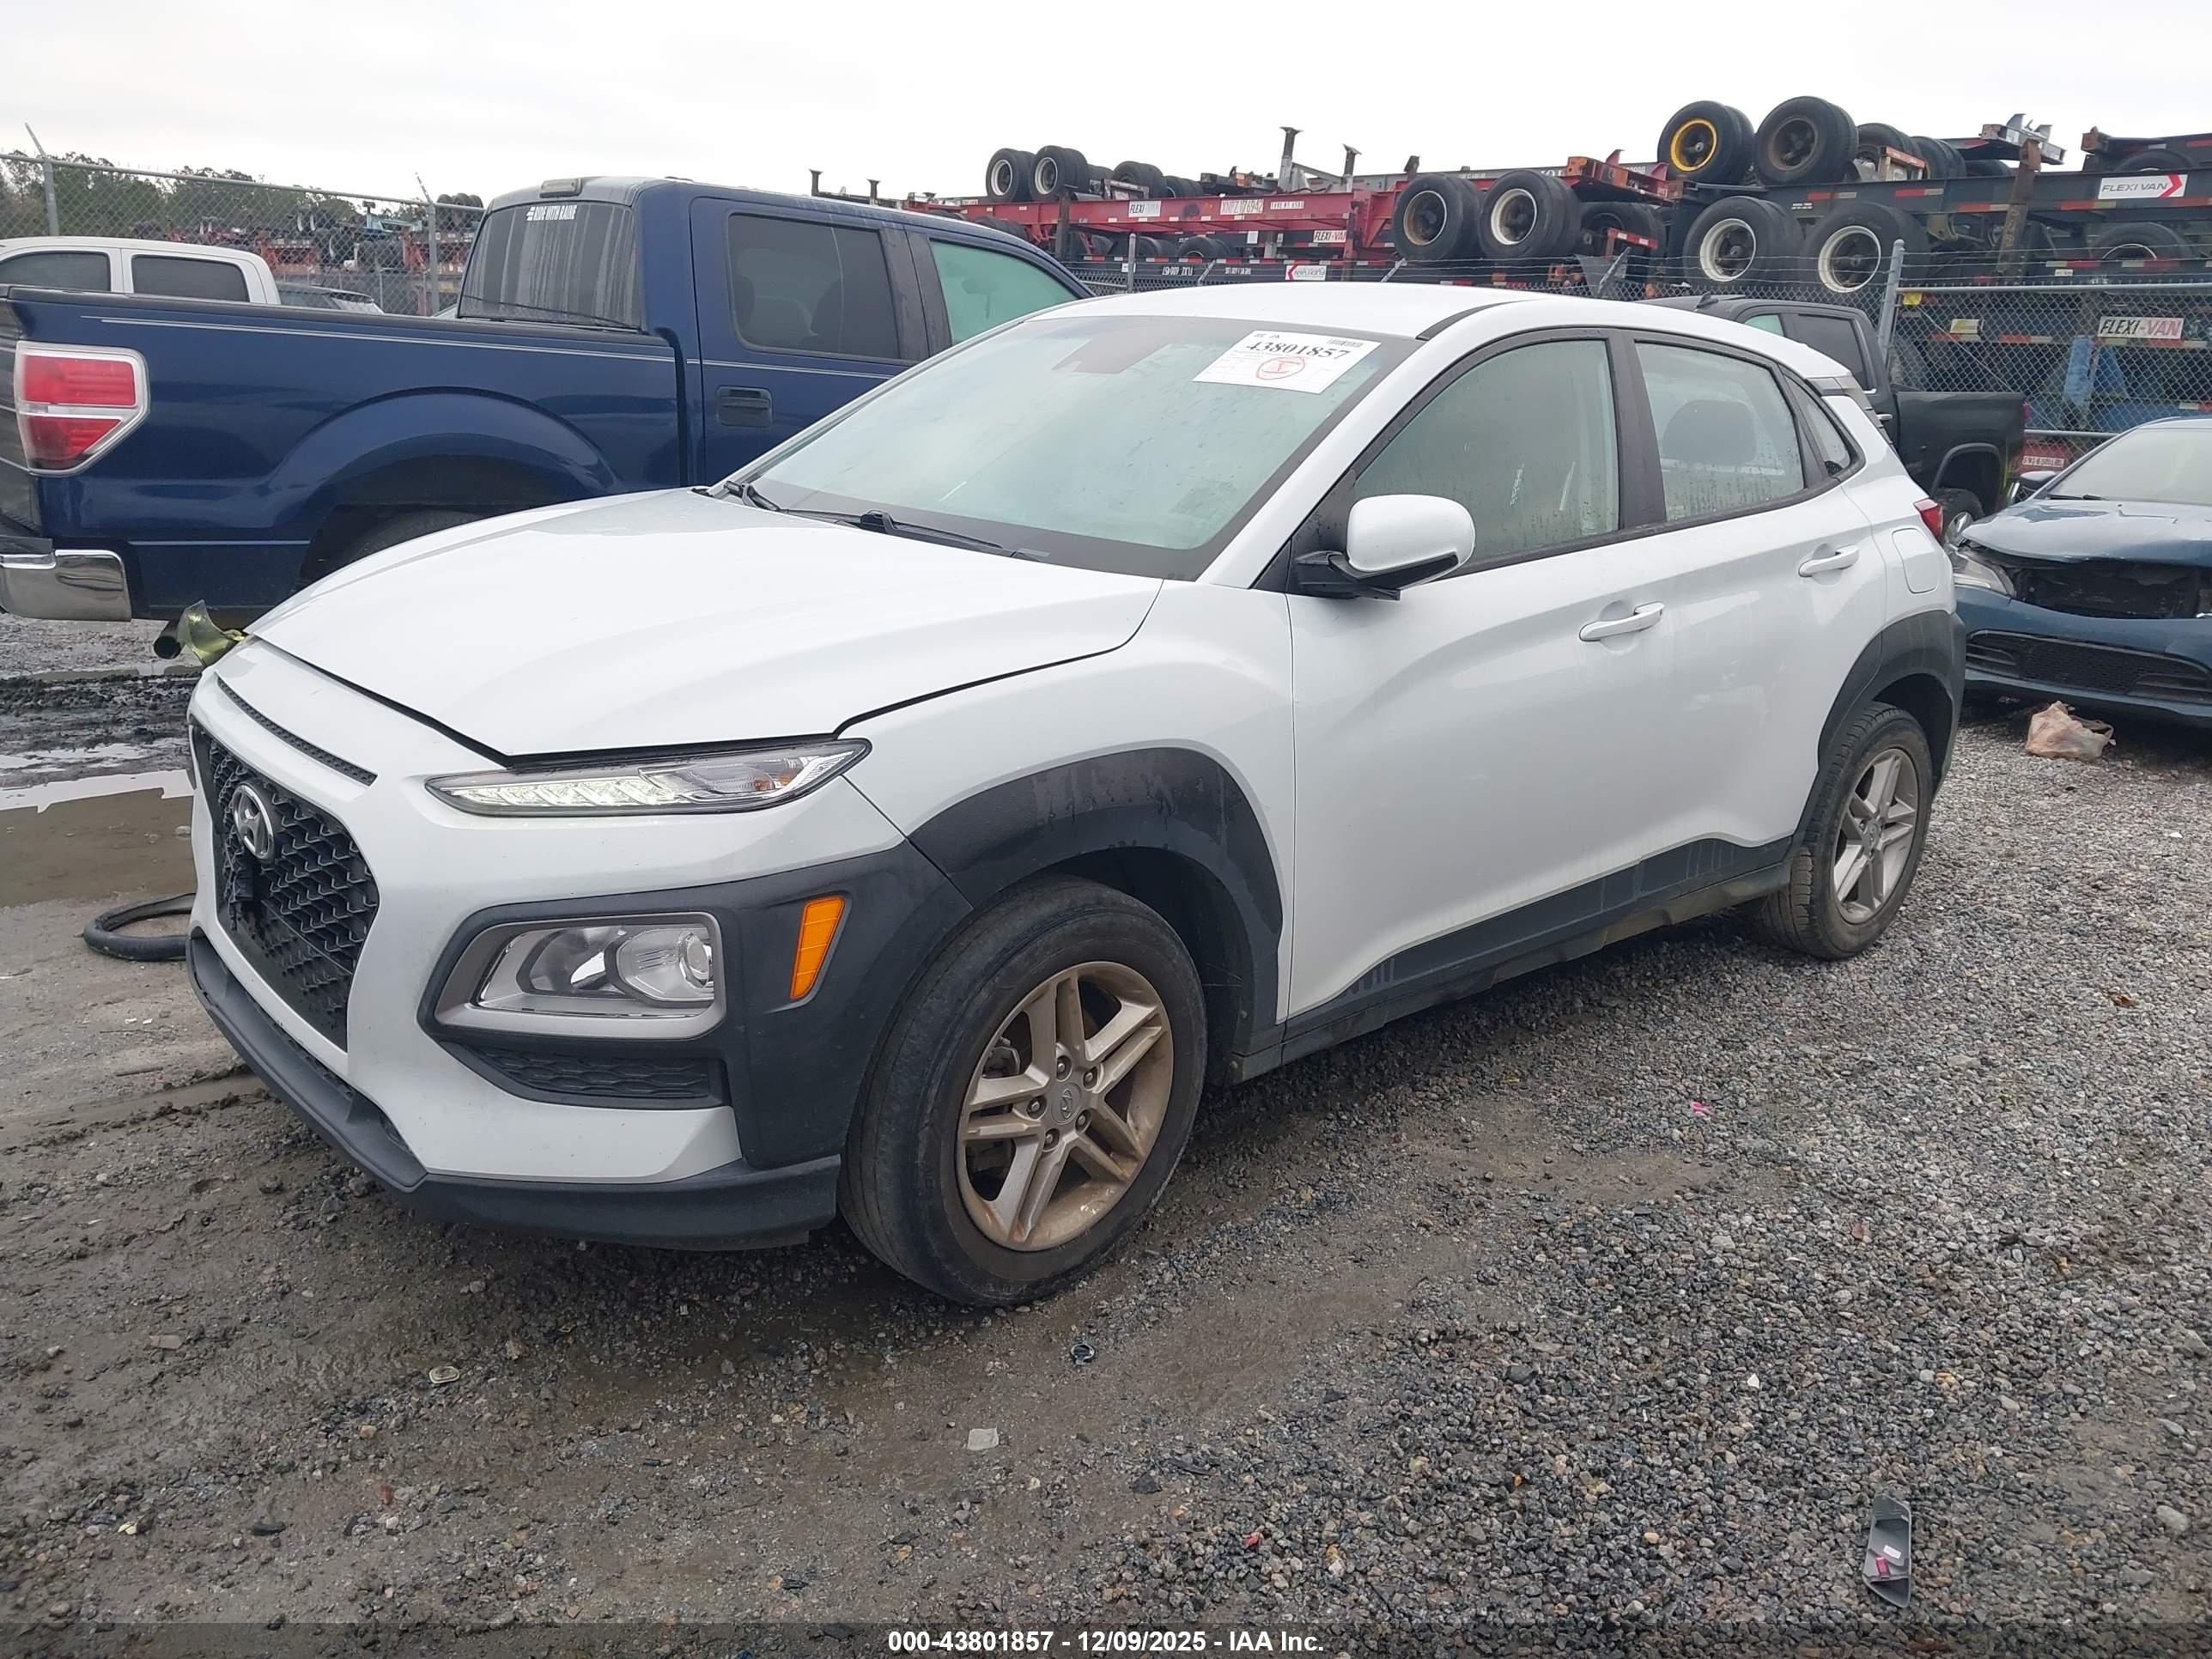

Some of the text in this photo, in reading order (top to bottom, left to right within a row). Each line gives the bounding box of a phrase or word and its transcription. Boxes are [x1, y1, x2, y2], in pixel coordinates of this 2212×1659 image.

[2101, 183, 2168, 192] FLEXI VAN
[2100, 319, 2182, 336] FLEXI-VAN
[1245, 341, 1352, 361] 43801857
